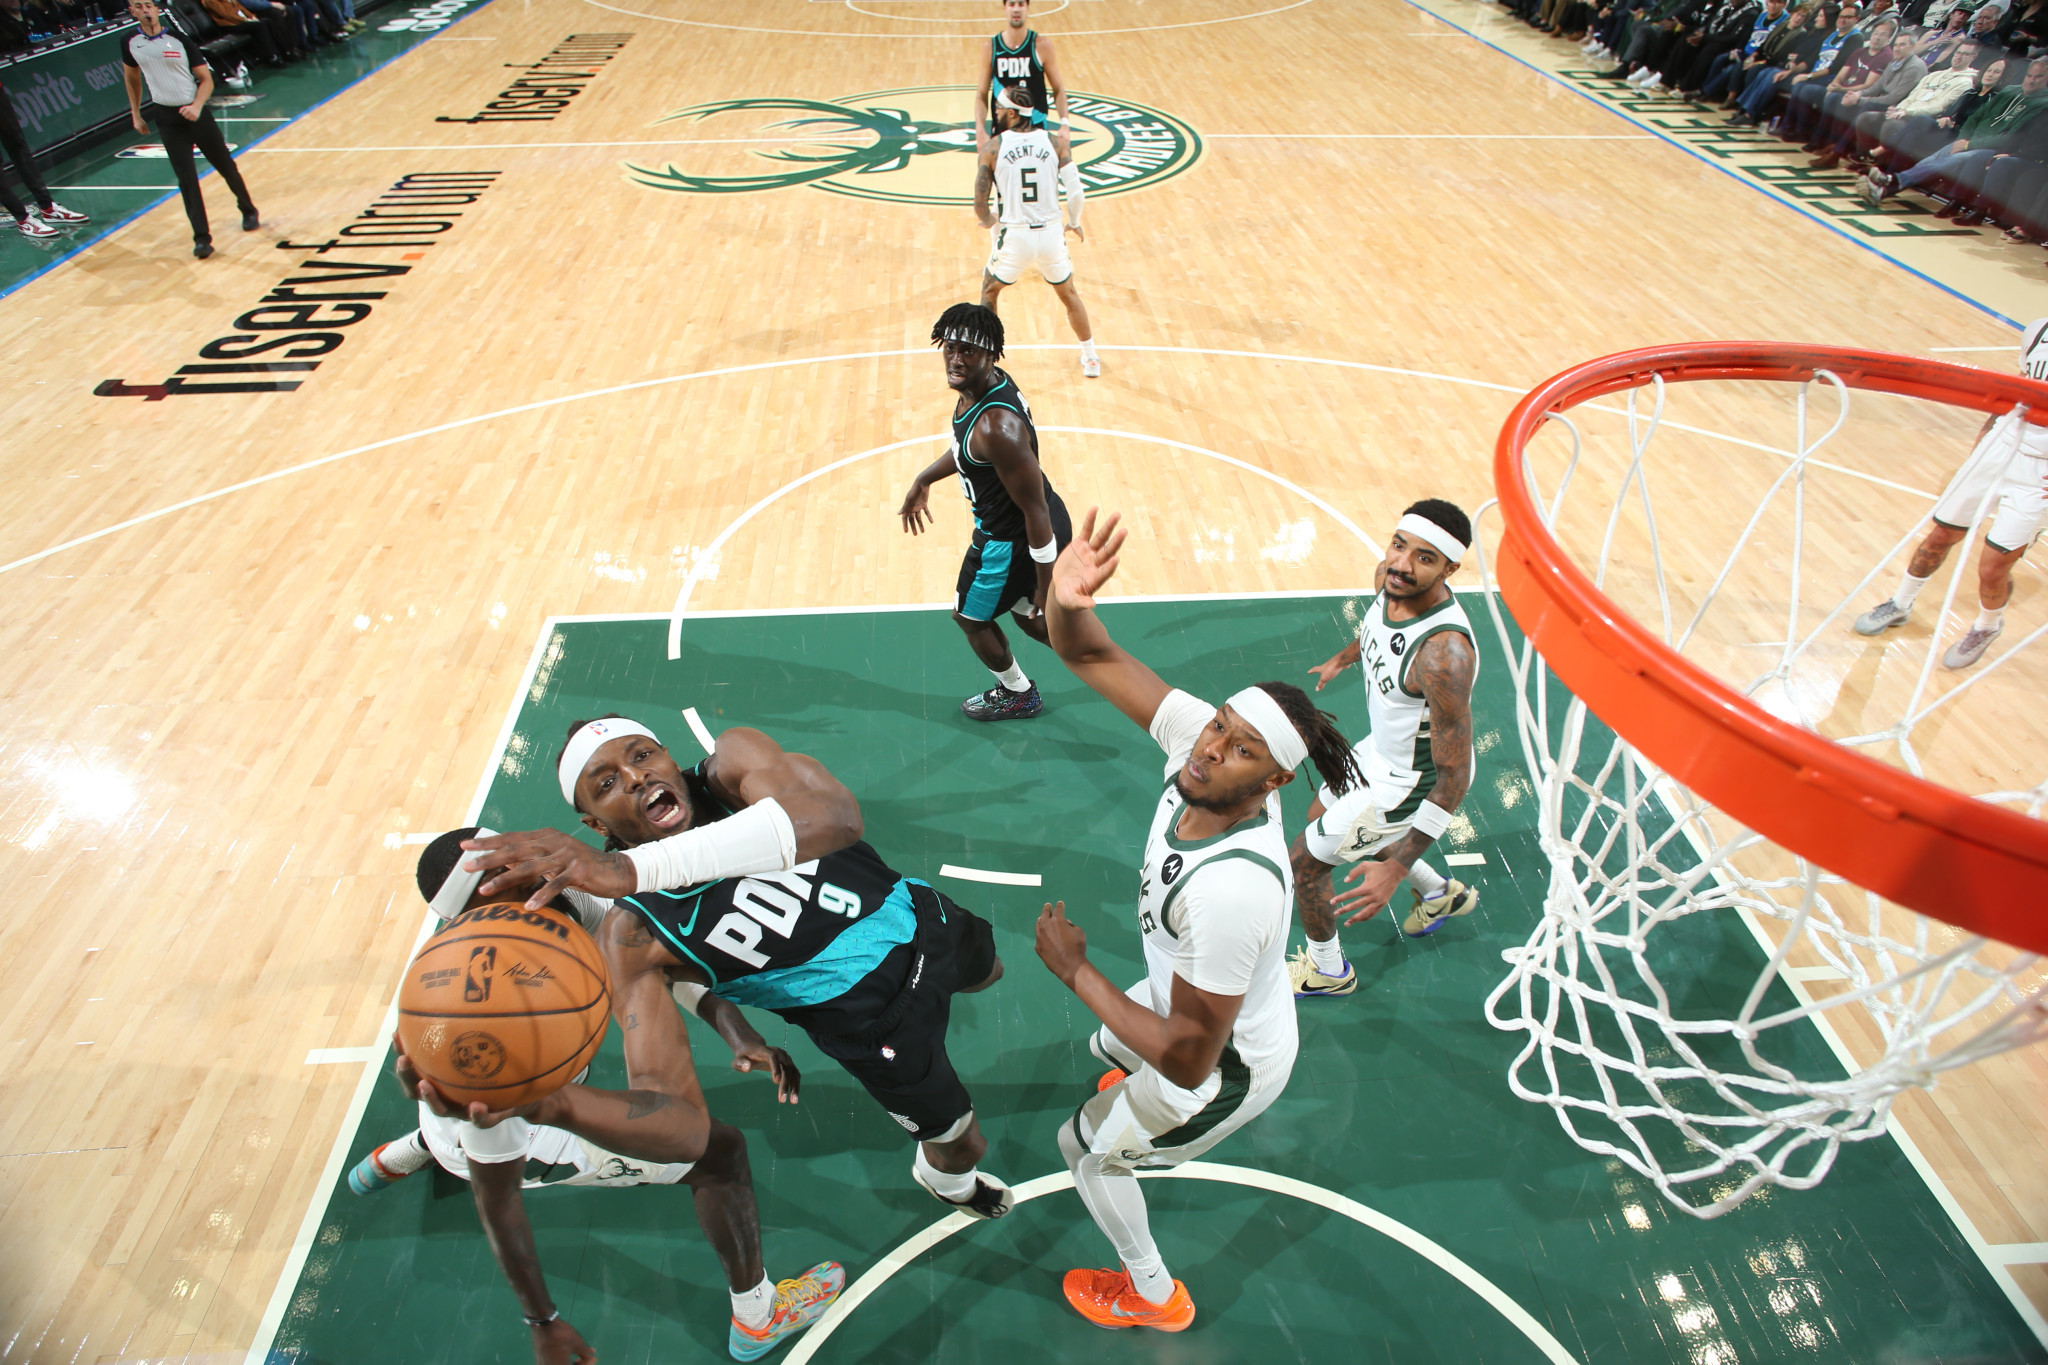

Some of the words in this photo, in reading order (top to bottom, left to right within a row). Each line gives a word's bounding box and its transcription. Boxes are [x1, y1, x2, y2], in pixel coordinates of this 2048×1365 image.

[84, 63, 120, 92] OBEY
[997, 57, 1031, 78] PDX
[1003, 144, 1034, 165] TRENT
[1035, 148, 1050, 163] JR
[1058, 121, 1177, 193] LWAUKEE
[1021, 167, 1038, 203] 5
[275, 171, 502, 253] forum
[1360, 625, 1395, 696] UCKS
[703, 858, 821, 970] PDX
[818, 881, 862, 919] 9
